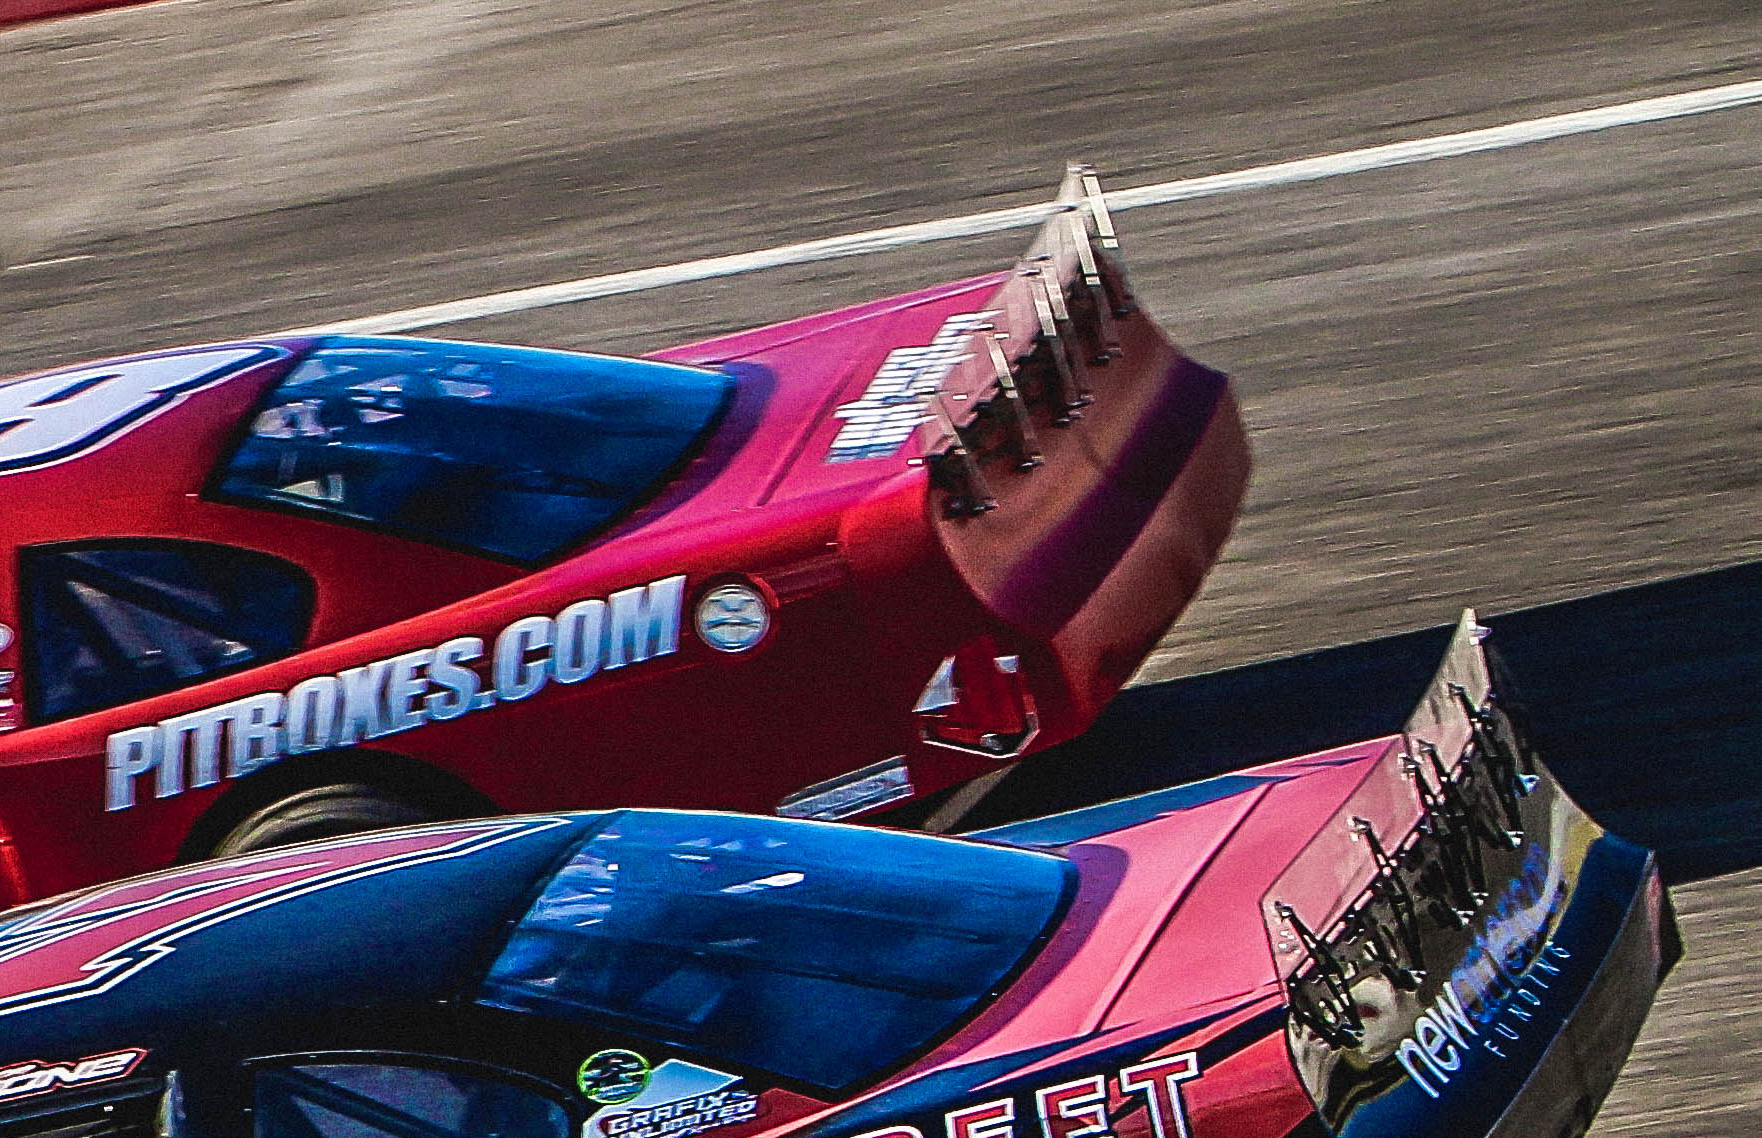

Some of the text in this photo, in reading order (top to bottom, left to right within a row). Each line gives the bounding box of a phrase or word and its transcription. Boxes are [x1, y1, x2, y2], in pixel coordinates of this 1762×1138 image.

[104, 574, 687, 812] PITBOXES.COM
[1483, 941, 1573, 1058] FUNDING
[607, 1090, 730, 1135] GRAFIX
